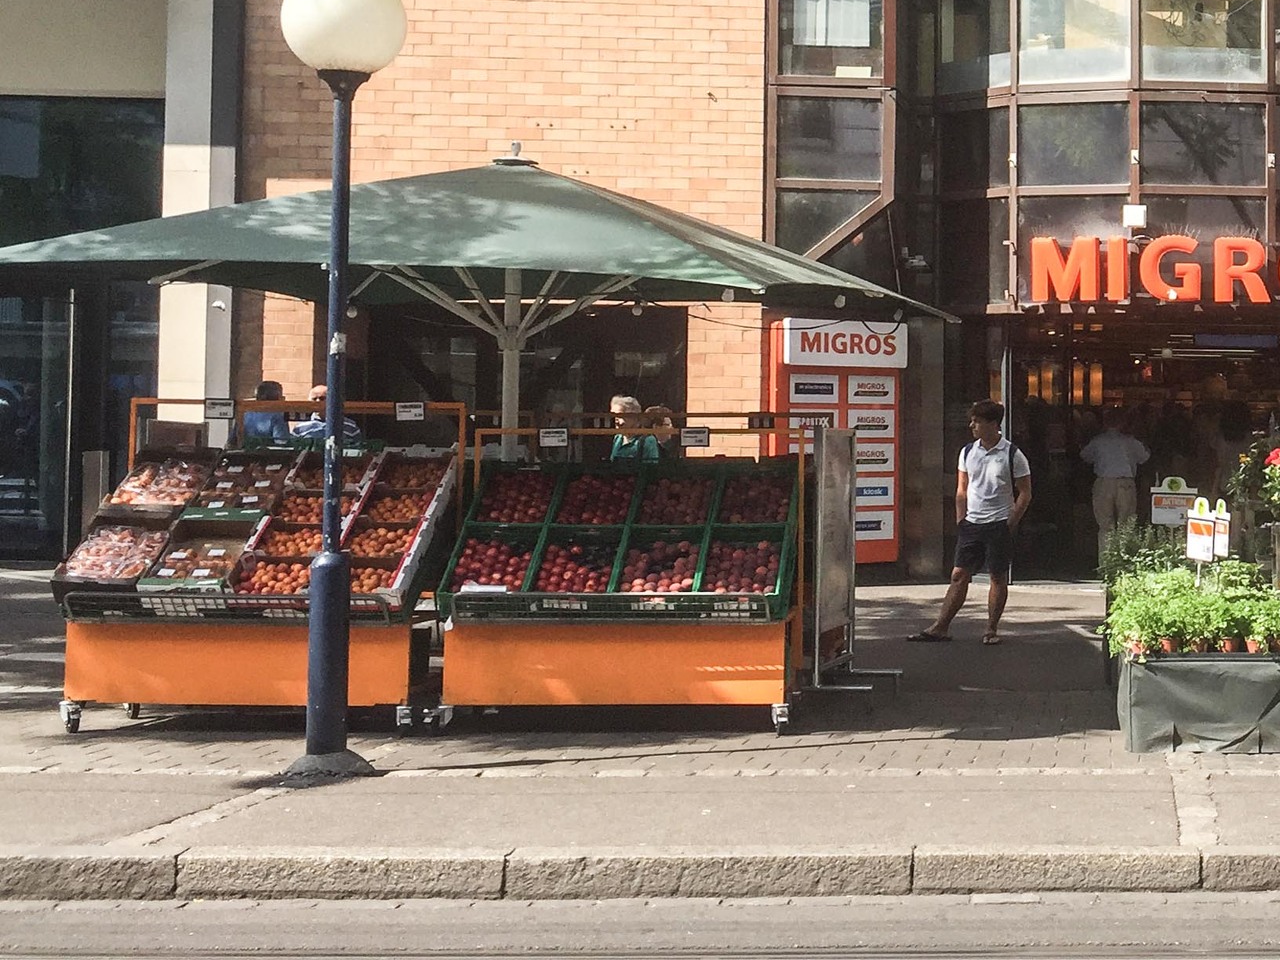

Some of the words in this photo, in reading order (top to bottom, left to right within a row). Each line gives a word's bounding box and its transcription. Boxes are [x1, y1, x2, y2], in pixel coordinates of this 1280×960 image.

[800, 331, 897, 356] MIGROS
[857, 382, 886, 390] MIGROS
[856, 416, 886, 424] MIGROS
[856, 450, 886, 458] MIGROS
[863, 487, 883, 496] kiosk
